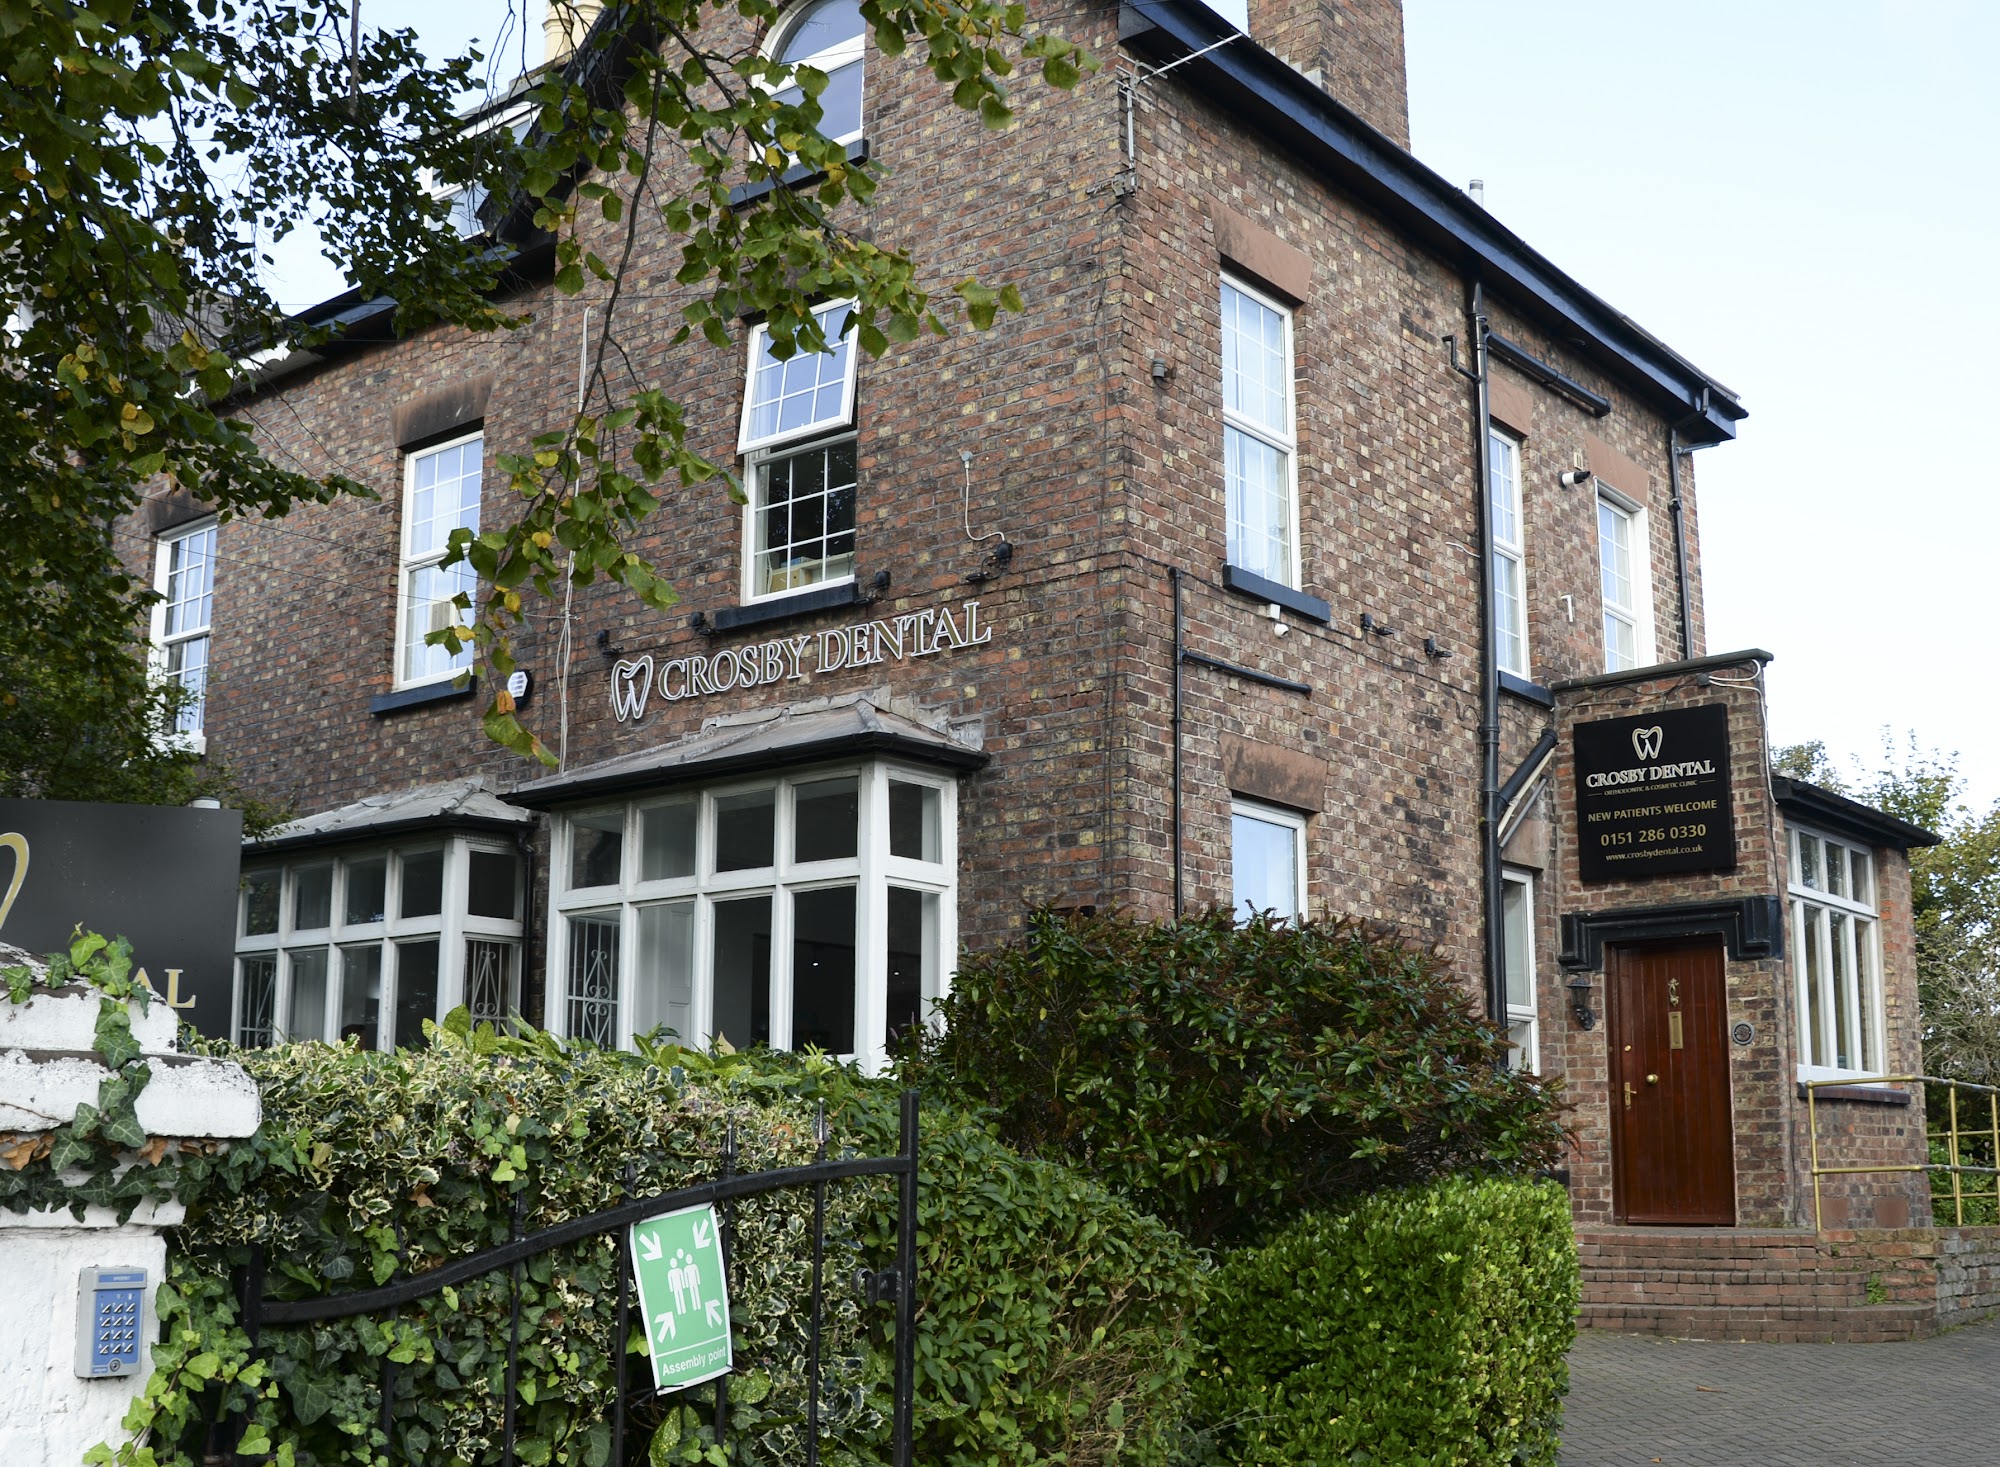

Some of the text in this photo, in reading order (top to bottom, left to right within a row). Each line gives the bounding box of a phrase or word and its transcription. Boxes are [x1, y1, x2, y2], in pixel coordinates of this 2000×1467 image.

[658, 601, 992, 701] CROSBY DENTAL
[1586, 760, 1715, 788] CROSBY DENTAL
[1604, 786, 1644, 796] ORTHODONTIC
[1650, 782, 1678, 790] COSMETIC
[1588, 800, 1717, 822] NEW PATIENTS WELCOME
[1601, 824, 1706, 846] 0151 286 0330
[1606, 845, 1702, 860] www.crosbydental.co.uk
[662, 1346, 726, 1376] Assembly point
